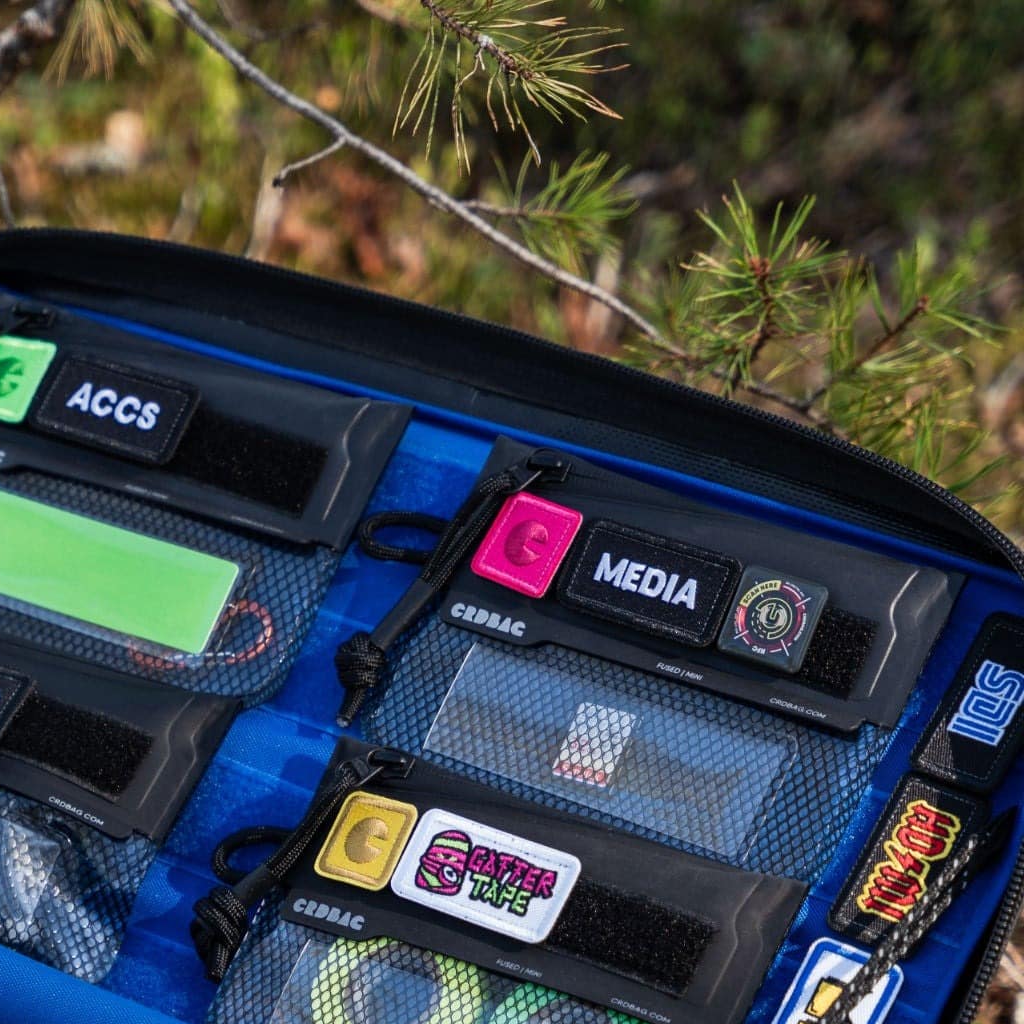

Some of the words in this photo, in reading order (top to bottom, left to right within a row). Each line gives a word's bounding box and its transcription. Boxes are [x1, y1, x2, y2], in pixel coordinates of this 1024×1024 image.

[66, 382, 161, 430] ACCS
[593, 552, 698, 610] MEDIA
[947, 660, 1024, 746] SDI
[469, 873, 534, 917] TAPE
